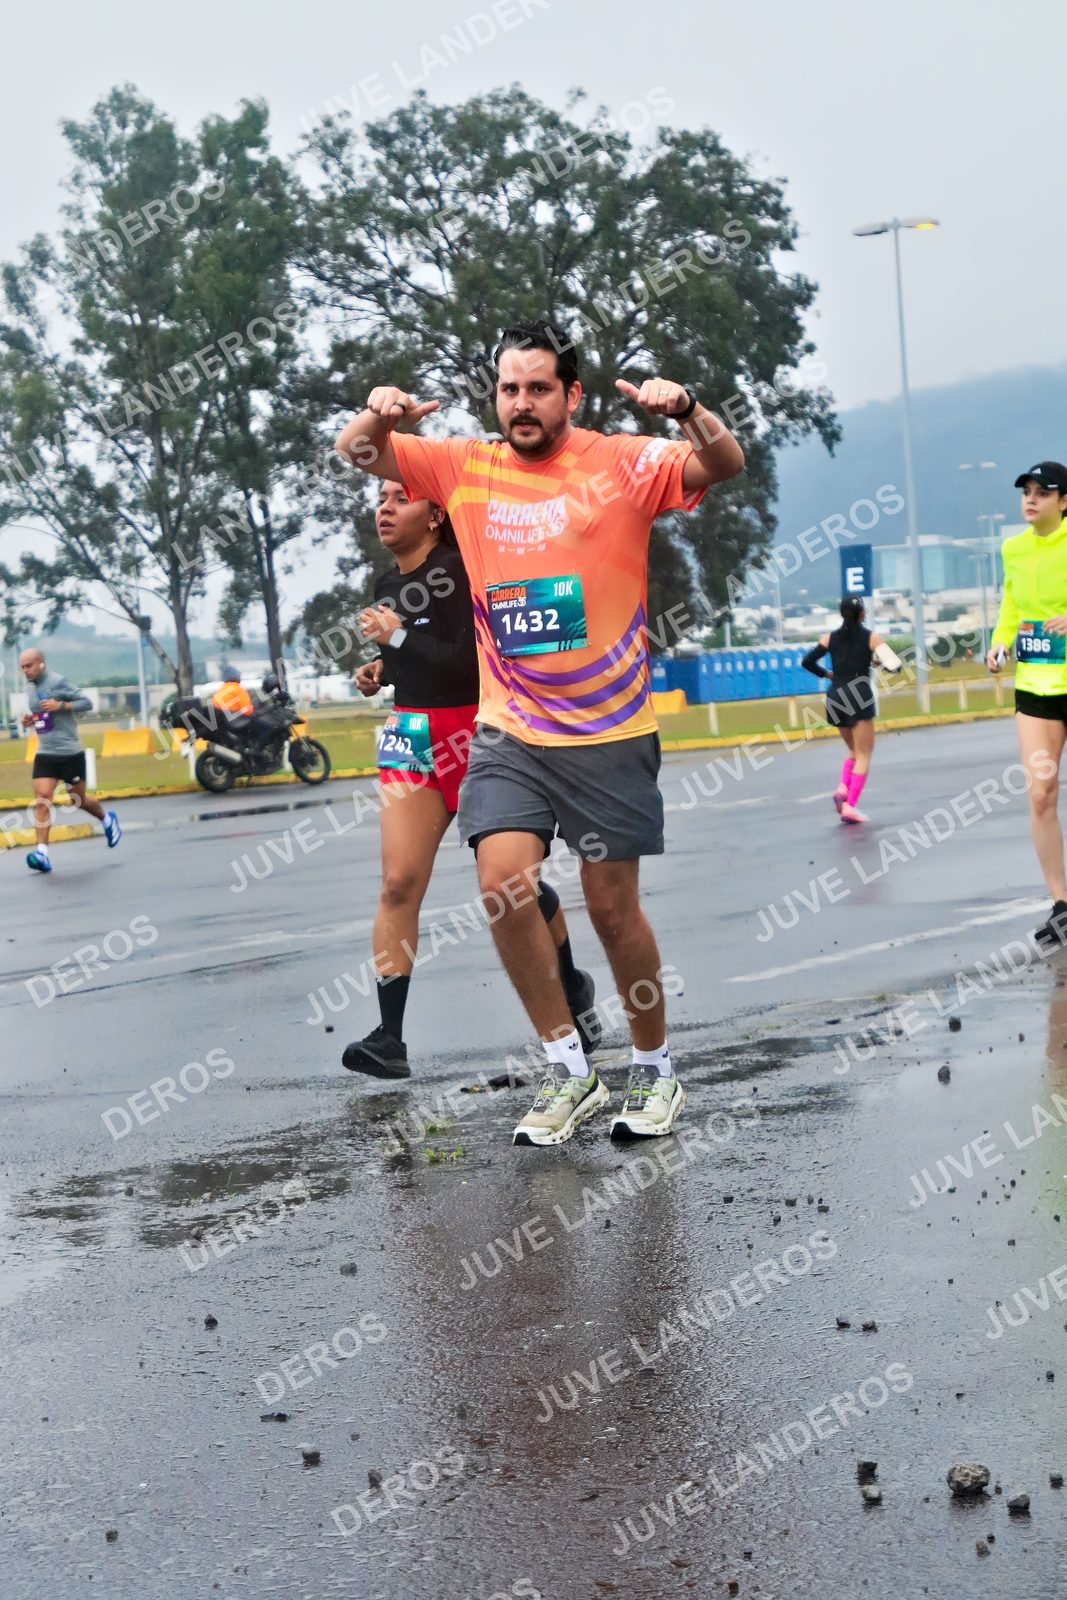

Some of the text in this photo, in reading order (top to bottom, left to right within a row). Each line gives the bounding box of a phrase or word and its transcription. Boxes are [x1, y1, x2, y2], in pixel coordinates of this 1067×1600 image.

[488, 495, 566, 527] CARRERA
[485, 525, 545, 544] OMNILIFE
[554, 580, 574, 597] 10K
[846, 566, 865, 592] E
[491, 586, 527, 603] CARRERA
[501, 609, 560, 635] 1432
[1020, 637, 1051, 653] 1386
[409, 717, 423, 731] 10K
[379, 733, 414, 755] 1242
